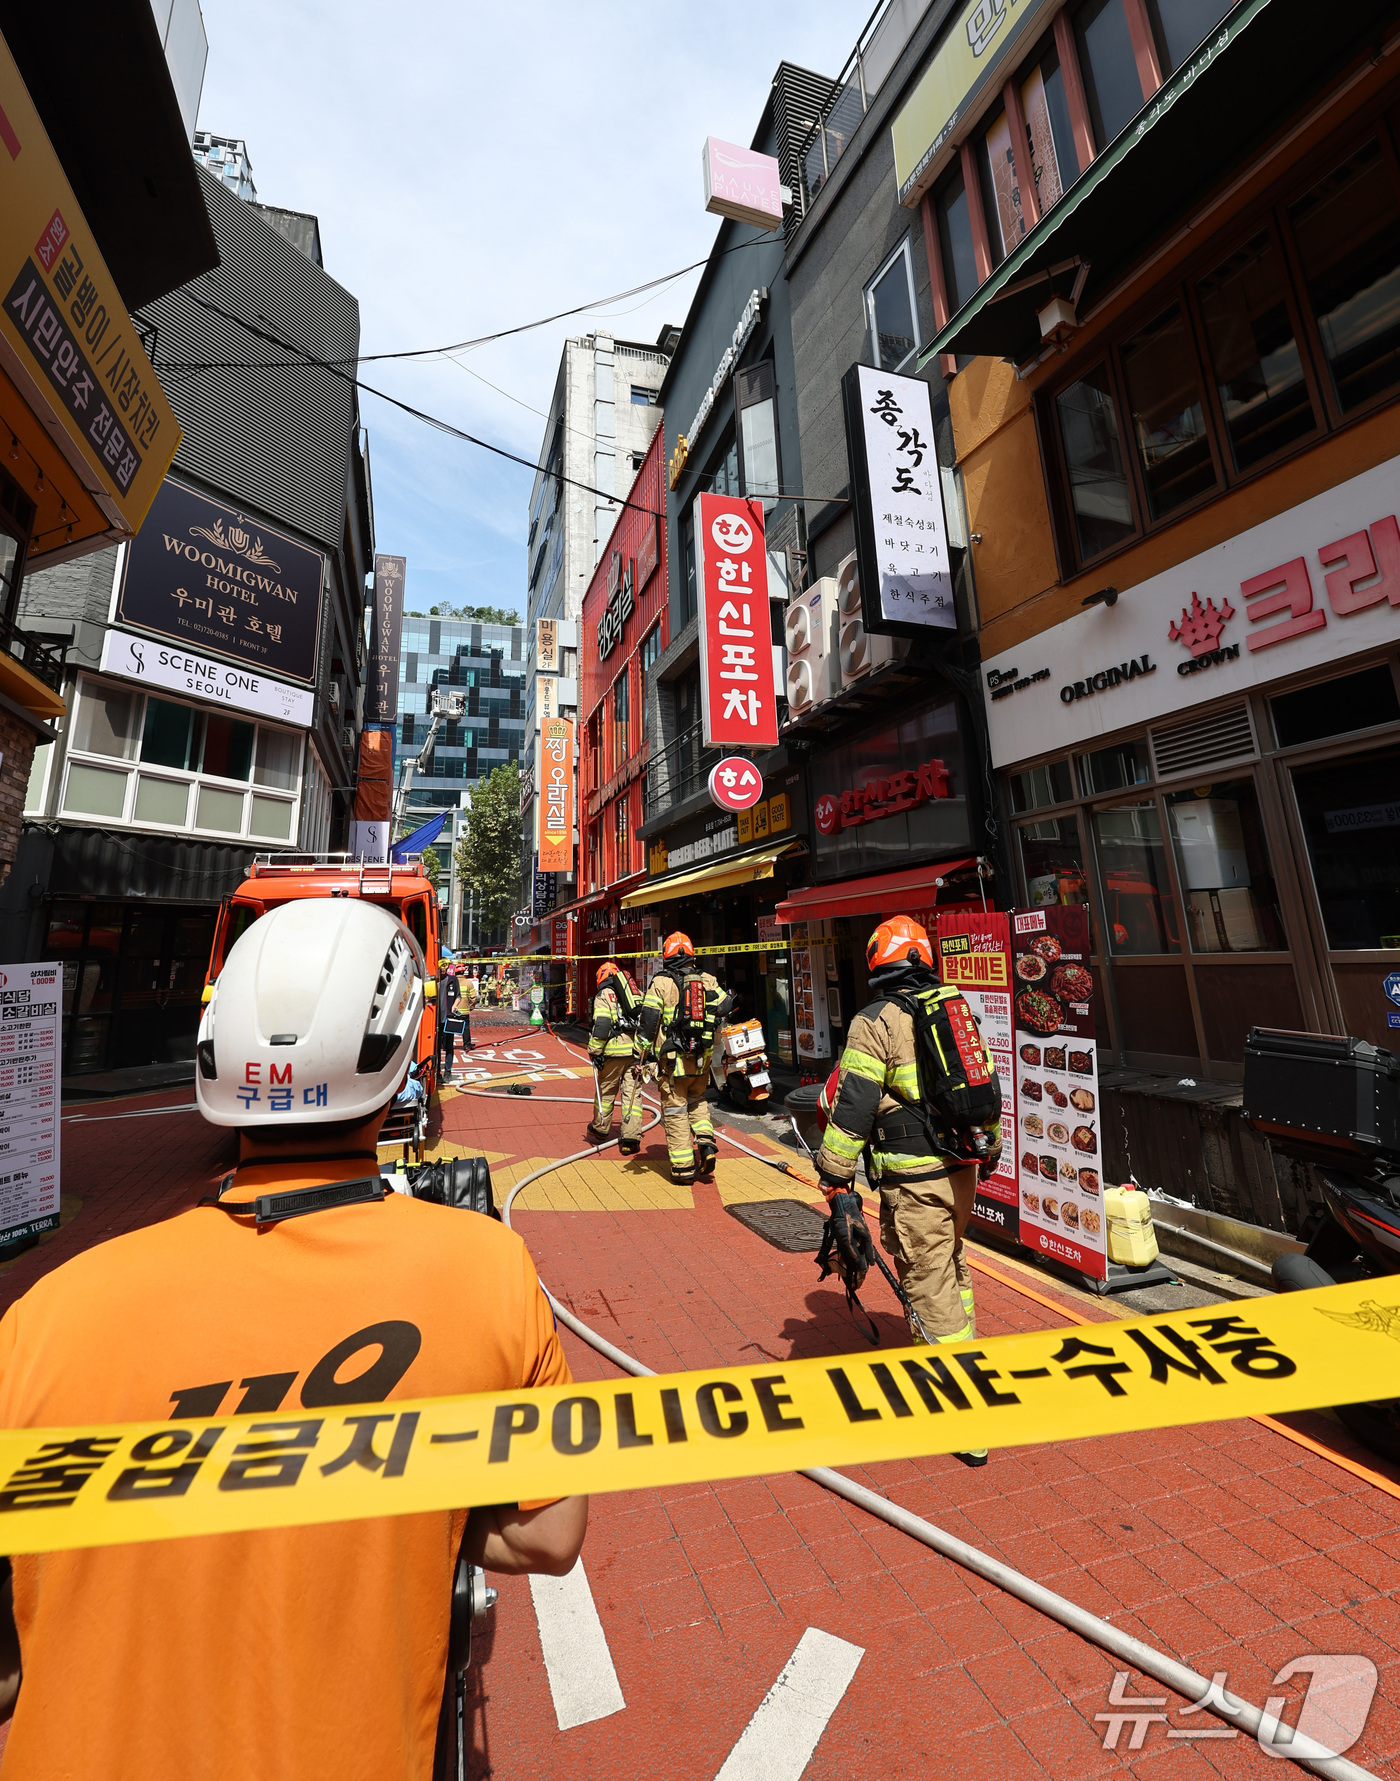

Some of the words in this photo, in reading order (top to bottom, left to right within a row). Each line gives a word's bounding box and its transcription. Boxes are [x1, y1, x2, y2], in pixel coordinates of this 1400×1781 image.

[1135, 87, 1177, 135] 종각도
[1183, 28, 1229, 83] 바다섬
[714, 171, 779, 201] MAUVE
[714, 182, 780, 211] PILATES
[12, 278, 96, 411] 시민안주
[89, 402, 138, 489] 전문점
[870, 390, 928, 497] 종각도
[882, 512, 938, 533] 제철숙성회
[162, 533, 299, 605] WOOMIGWAN
[205, 574, 259, 607] HOTEL
[889, 588, 945, 608] 한식주점
[170, 586, 237, 627] 우미관
[244, 615, 283, 645] 호텔
[380, 578, 395, 654] WOOMIGWAN
[177, 616, 193, 630] TEL:
[239, 639, 260, 653] FRONT
[540, 620, 554, 661] 미용실
[715, 557, 763, 728] 한신포차
[158, 651, 218, 681] SCENE
[225, 672, 260, 694] ONE
[541, 661, 553, 669] 2F
[1060, 654, 1157, 704] ORIGINAL
[1176, 643, 1241, 677] CROWN
[186, 678, 232, 700] SEOUL
[274, 686, 304, 700] BOUTIQUE
[281, 695, 296, 705] STAY
[373, 663, 392, 715] 우미관
[283, 708, 292, 718] 2F
[838, 758, 950, 828] 한신포차
[770, 803, 785, 815] GOOD
[771, 812, 785, 824] TASTE
[739, 817, 750, 828] TAKE
[740, 826, 750, 835] OUT
[547, 900, 556, 908] 4F
[1016, 914, 1045, 932] 대표메뉴
[941, 937, 968, 953] 한신포차
[31, 976, 55, 985] 1,000원
[945, 956, 1004, 982] 할인세트
[2, 1002, 57, 1020] 소갈비살
[1, 1022, 32, 1032] 소고기한판
[951, 1005, 981, 1080] 119구조대
[960, 1003, 990, 1079] 종로소방서
[987, 1037, 1010, 1048] 32,500
[236, 1082, 328, 1111] 구급대
[30, 1218, 53, 1233] TERRA
[1049, 1238, 1082, 1263] 한신포차
